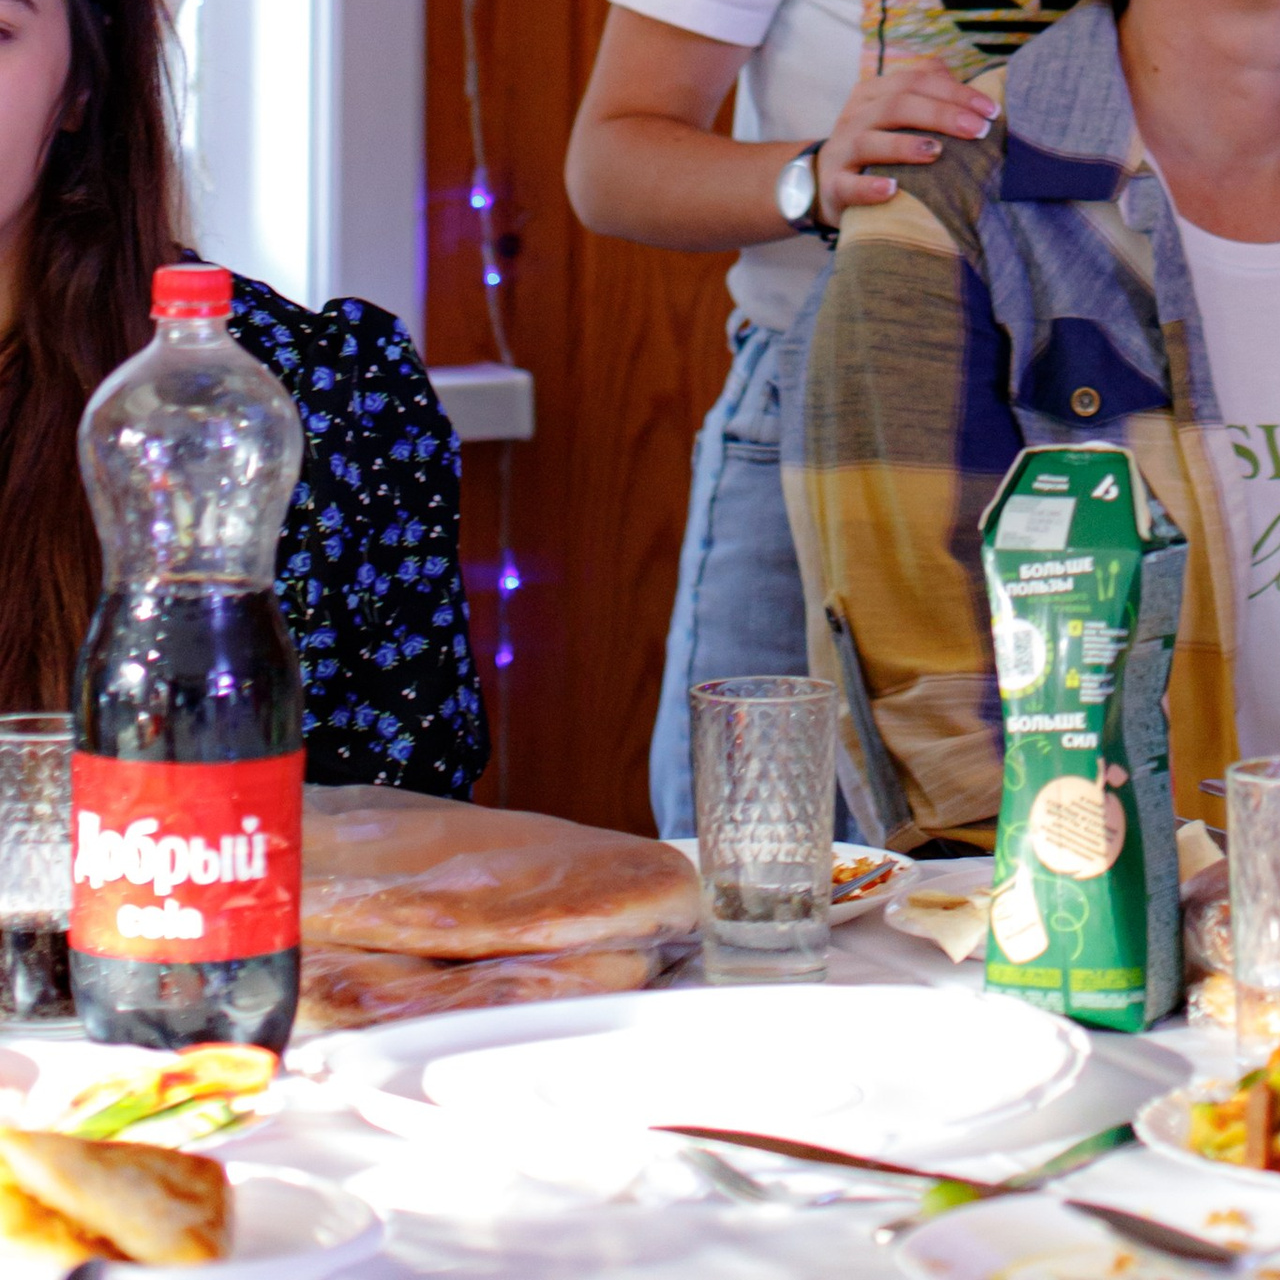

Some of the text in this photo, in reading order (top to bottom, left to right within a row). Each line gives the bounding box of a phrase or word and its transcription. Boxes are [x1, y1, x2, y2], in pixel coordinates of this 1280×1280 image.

[1019, 556, 1095, 580] БОЛЬШЕ
[1006, 711, 1087, 733] БОЛЬШЕ
[74, 810, 266, 897] Добрый
